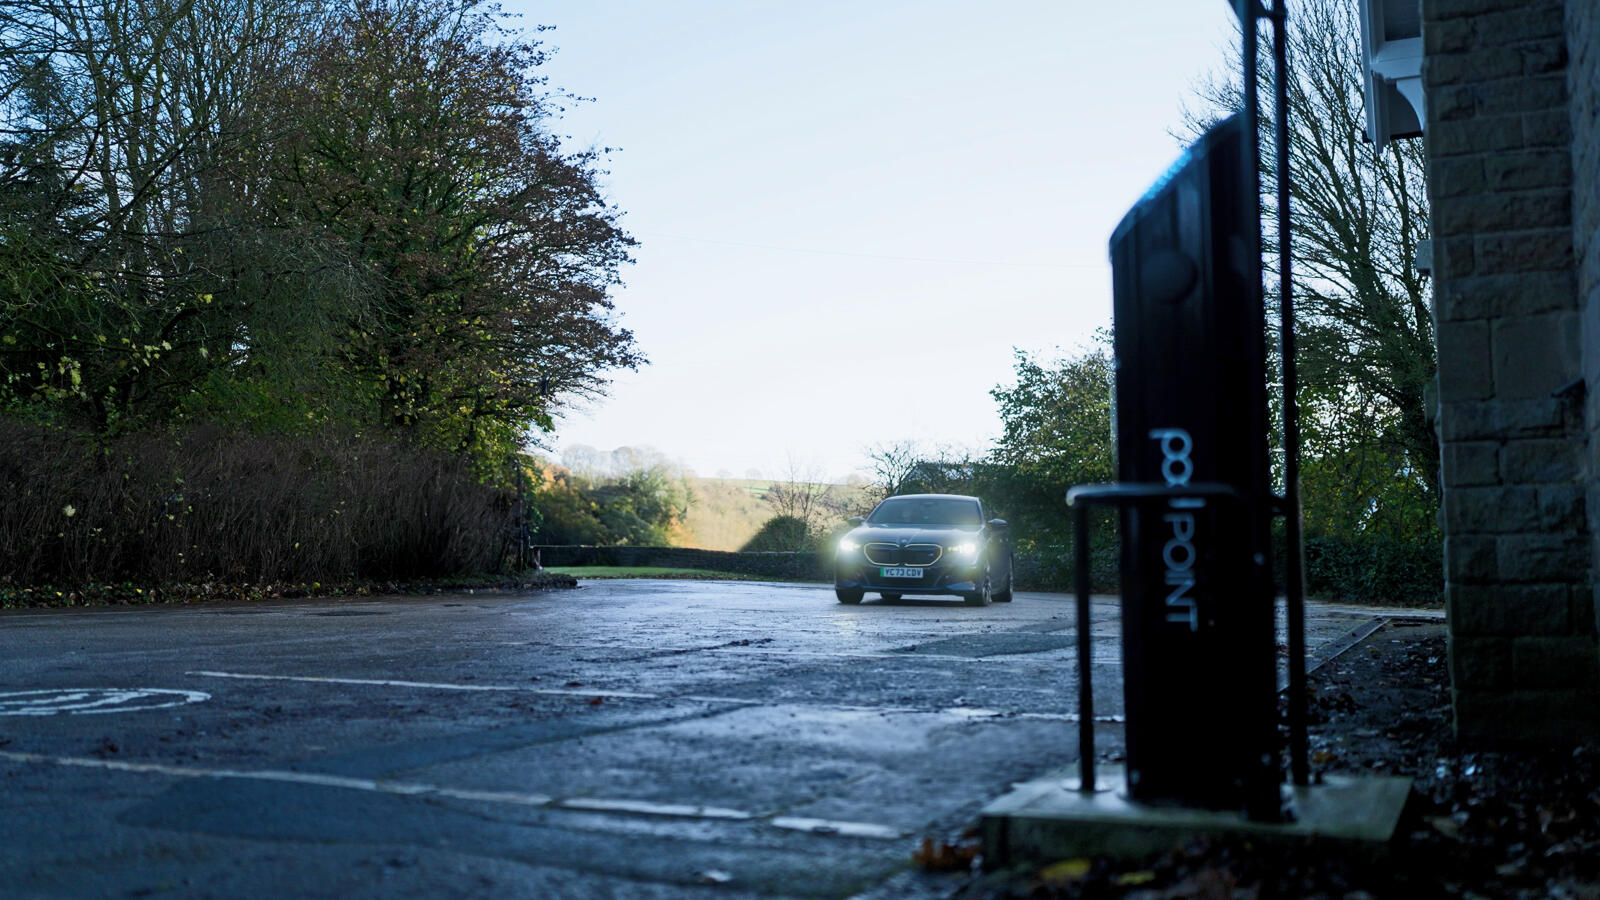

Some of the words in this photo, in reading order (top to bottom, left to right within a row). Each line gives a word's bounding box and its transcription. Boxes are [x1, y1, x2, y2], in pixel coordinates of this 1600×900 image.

[885, 568, 905, 577] YC73
[906, 568, 922, 577] CDV
[1163, 512, 1198, 632] POINT
